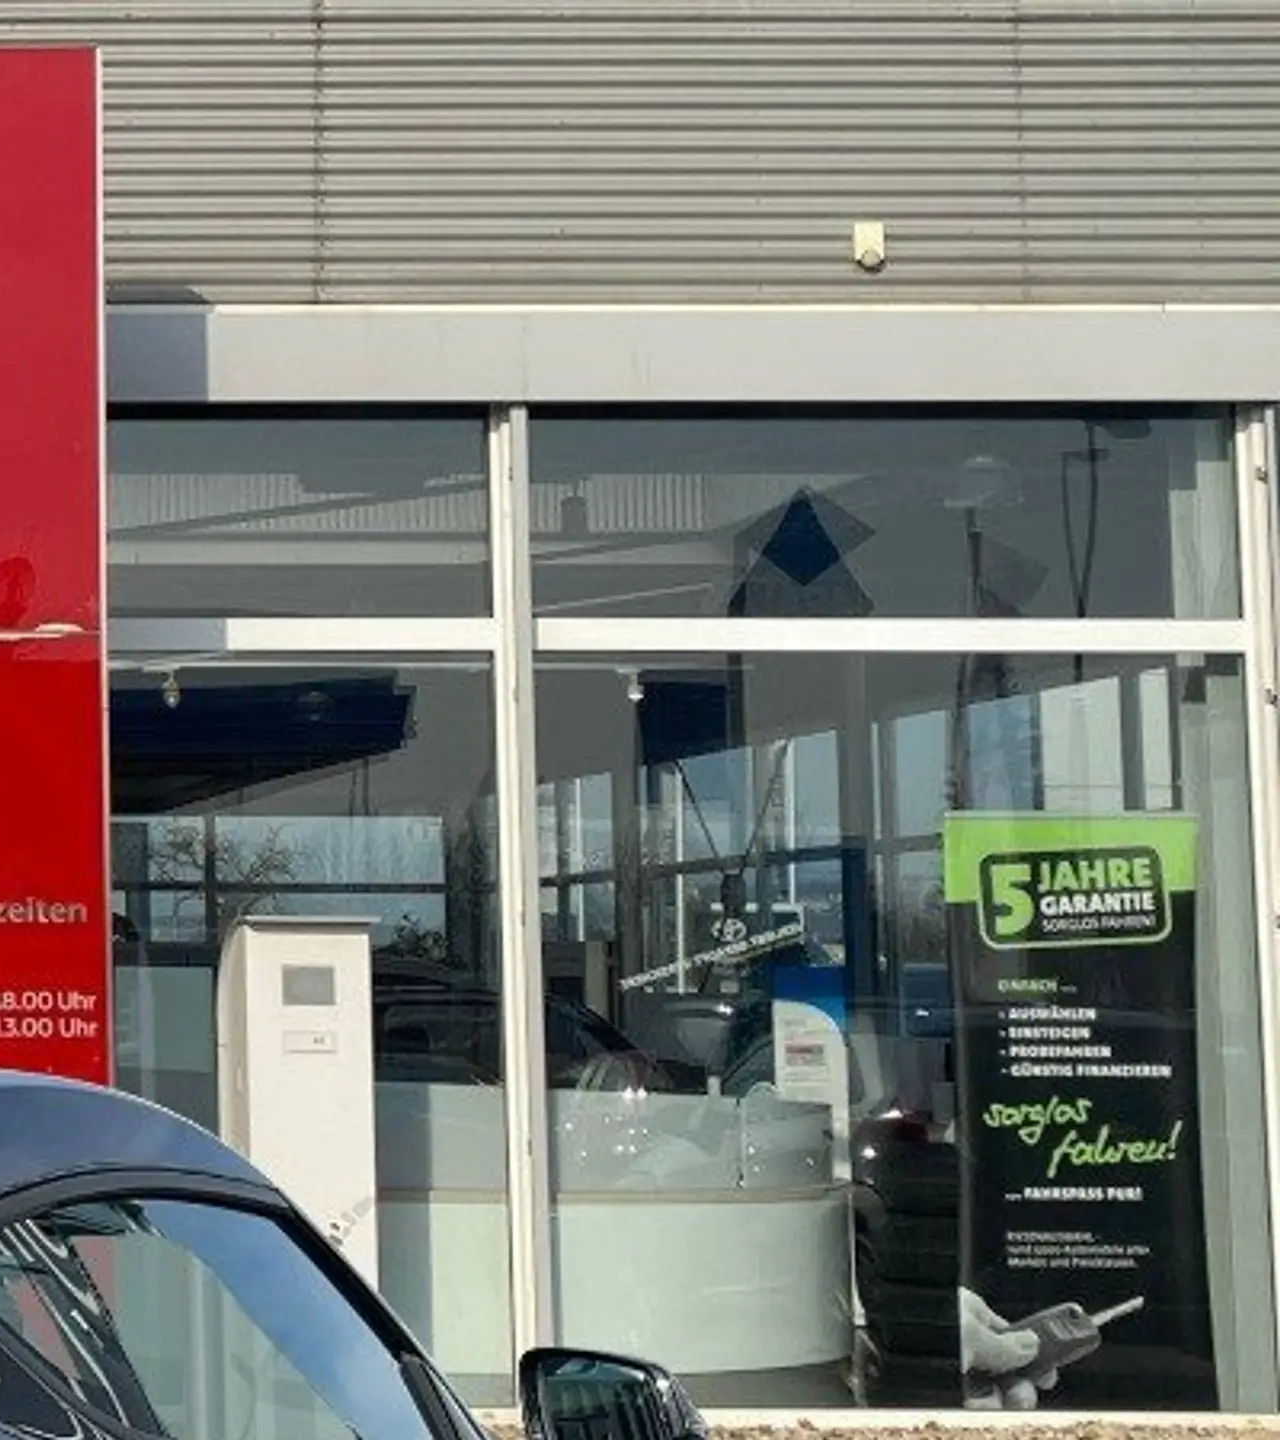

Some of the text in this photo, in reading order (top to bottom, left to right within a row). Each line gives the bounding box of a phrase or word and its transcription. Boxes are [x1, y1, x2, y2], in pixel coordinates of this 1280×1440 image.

[1037, 857, 1153, 893] JAHRE
[991, 863, 1035, 936] 5
[1039, 891, 1156, 917] GARANTIE
[57, 991, 97, 1010] Uhr
[59, 1018, 99, 1037] Uhr
